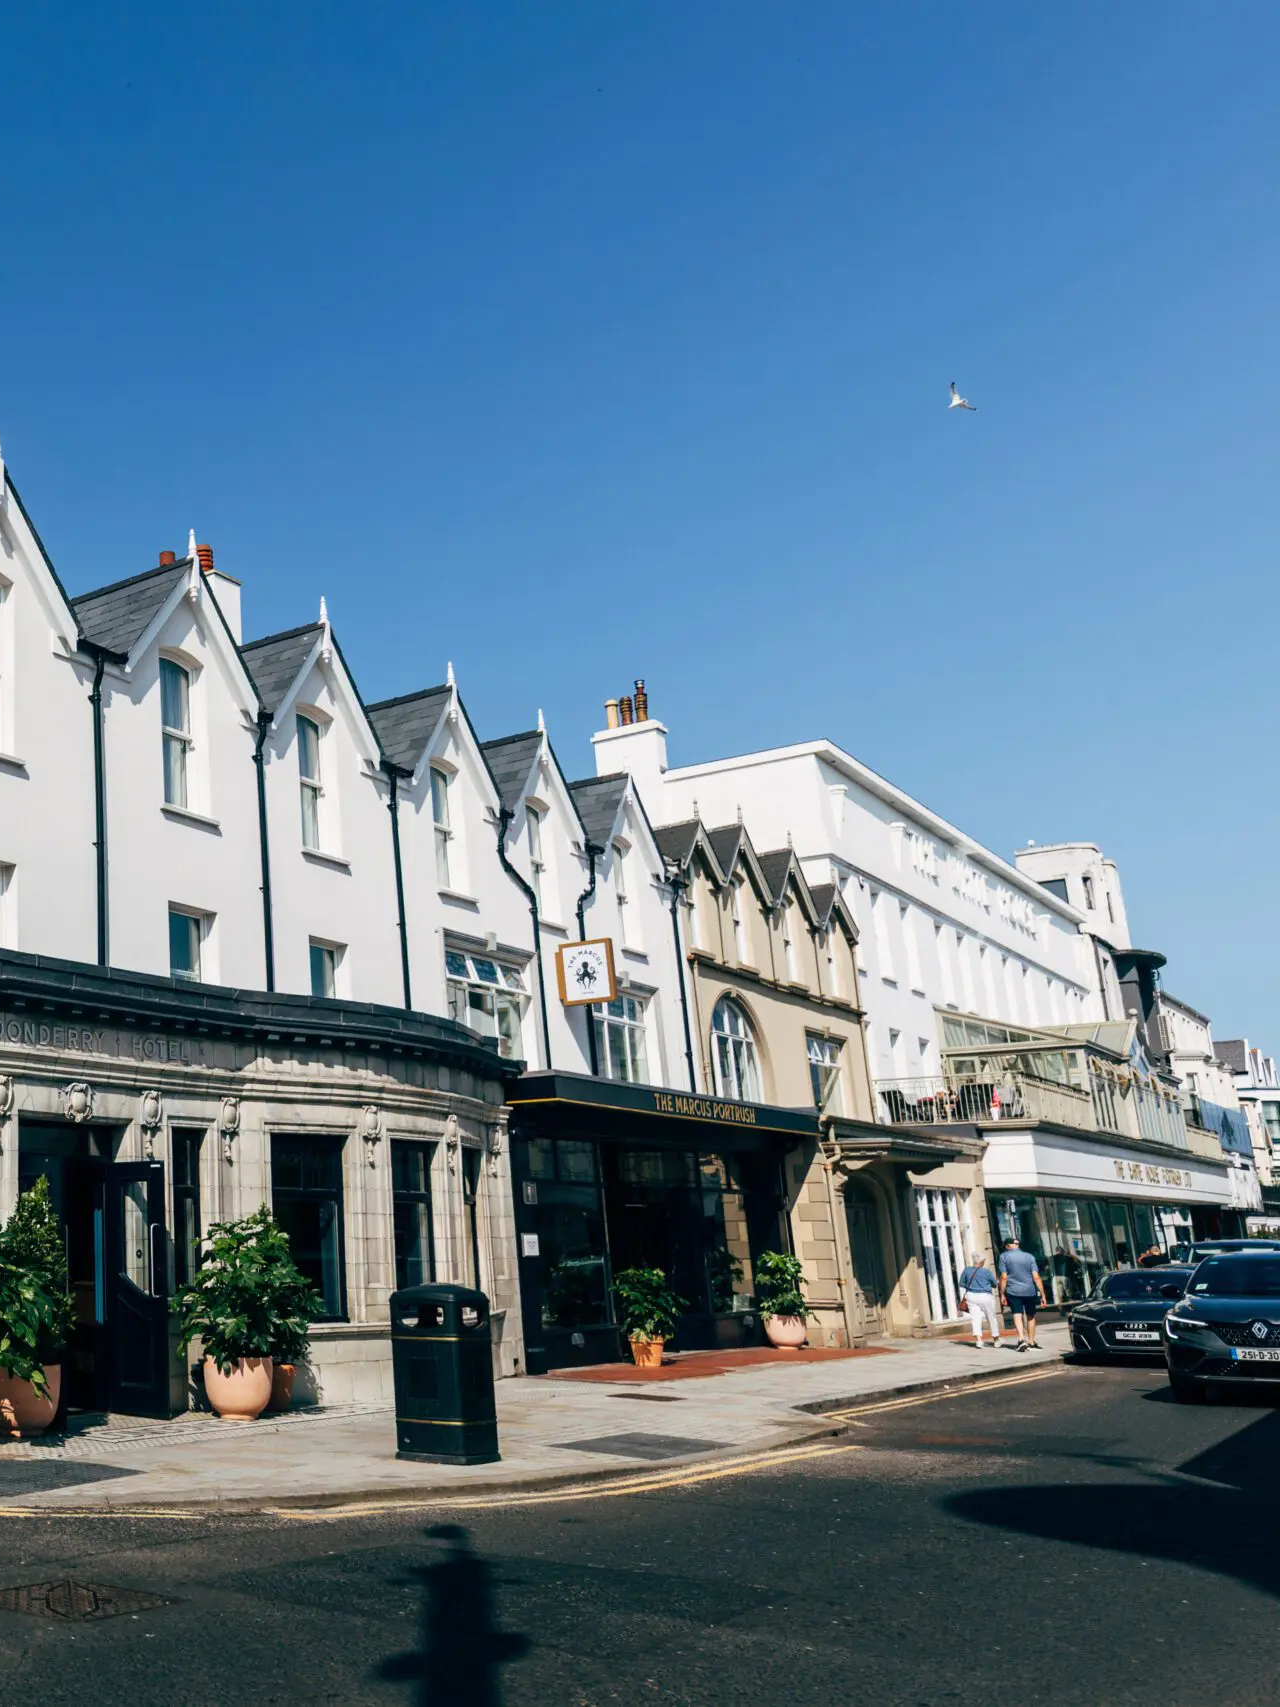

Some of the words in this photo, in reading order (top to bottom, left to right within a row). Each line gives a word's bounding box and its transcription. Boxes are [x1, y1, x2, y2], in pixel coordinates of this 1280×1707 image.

[578, 950, 602, 966] MARCUS
[132, 1036, 190, 1065] HOTEL
[654, 1092, 674, 1112] THE
[675, 1095, 712, 1118] MARCUS
[712, 1102, 756, 1124] PORTRUSH
[1241, 1350, 1280, 1361] 251-D-30
